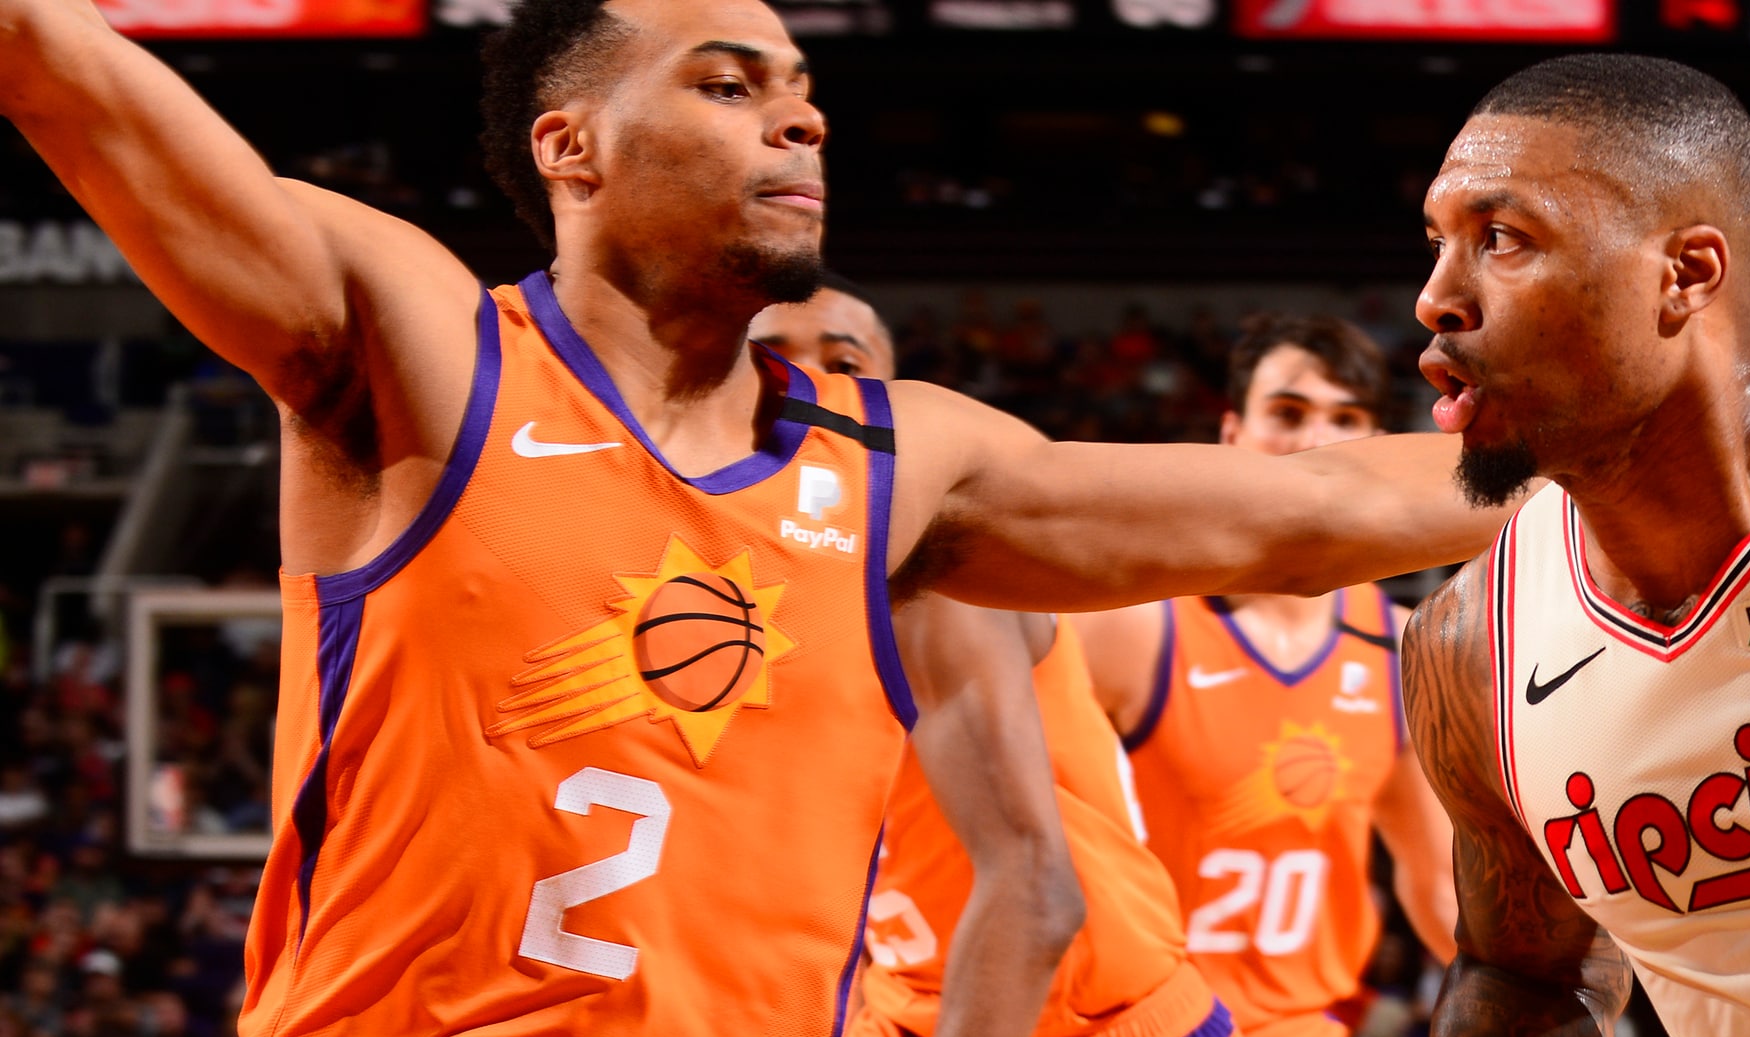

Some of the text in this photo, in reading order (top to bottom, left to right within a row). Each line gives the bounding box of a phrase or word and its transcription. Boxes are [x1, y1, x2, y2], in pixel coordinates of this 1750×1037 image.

[780, 519, 857, 554] PayPal
[518, 766, 672, 982] 2
[1186, 848, 1330, 956] 20
